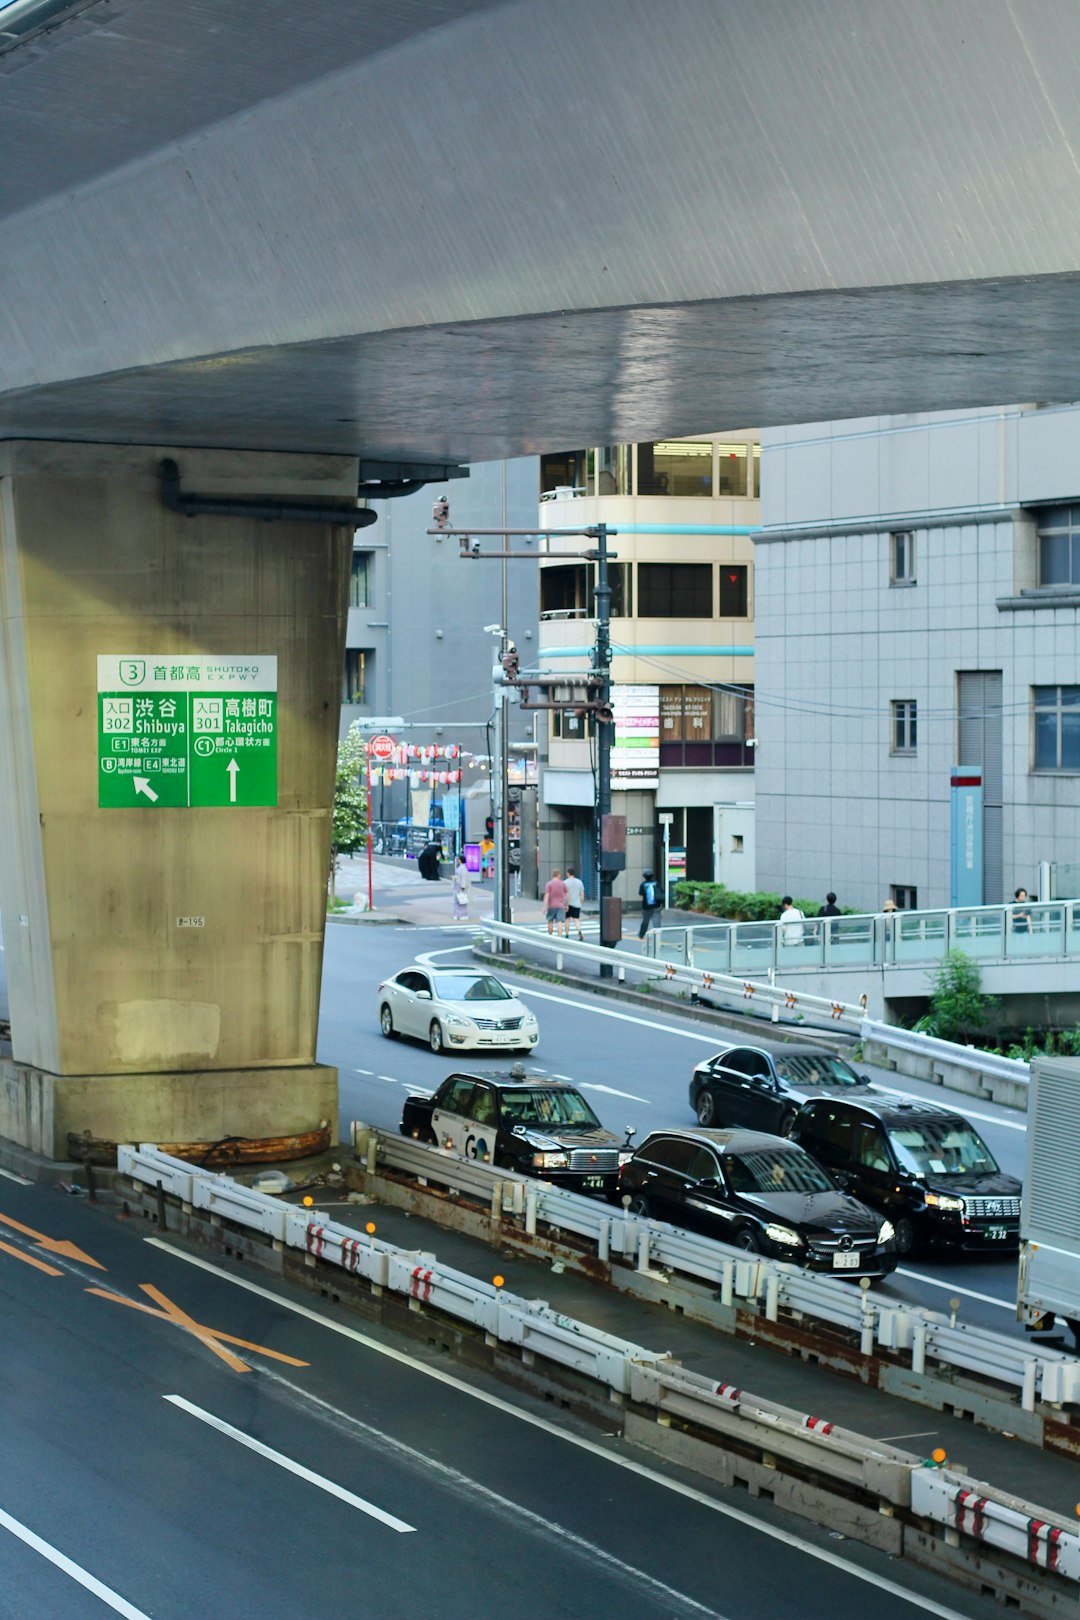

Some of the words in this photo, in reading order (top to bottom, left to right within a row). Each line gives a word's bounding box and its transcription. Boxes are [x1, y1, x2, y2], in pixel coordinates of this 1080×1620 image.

[129, 665, 138, 680] 3
[153, 666, 201, 681] 首都高
[106, 702, 130, 714] 入口
[135, 698, 177, 718] 渋谷
[196, 702, 220, 714] 入口
[225, 698, 273, 718] 高樹町
[106, 718, 130, 730] 302
[135, 719, 185, 736] Shibuya
[196, 718, 220, 730] 301
[225, 719, 273, 736] Takagicho
[114, 739, 128, 750] E1
[197, 740, 210, 753] C1
[146, 760, 158, 769] E4
